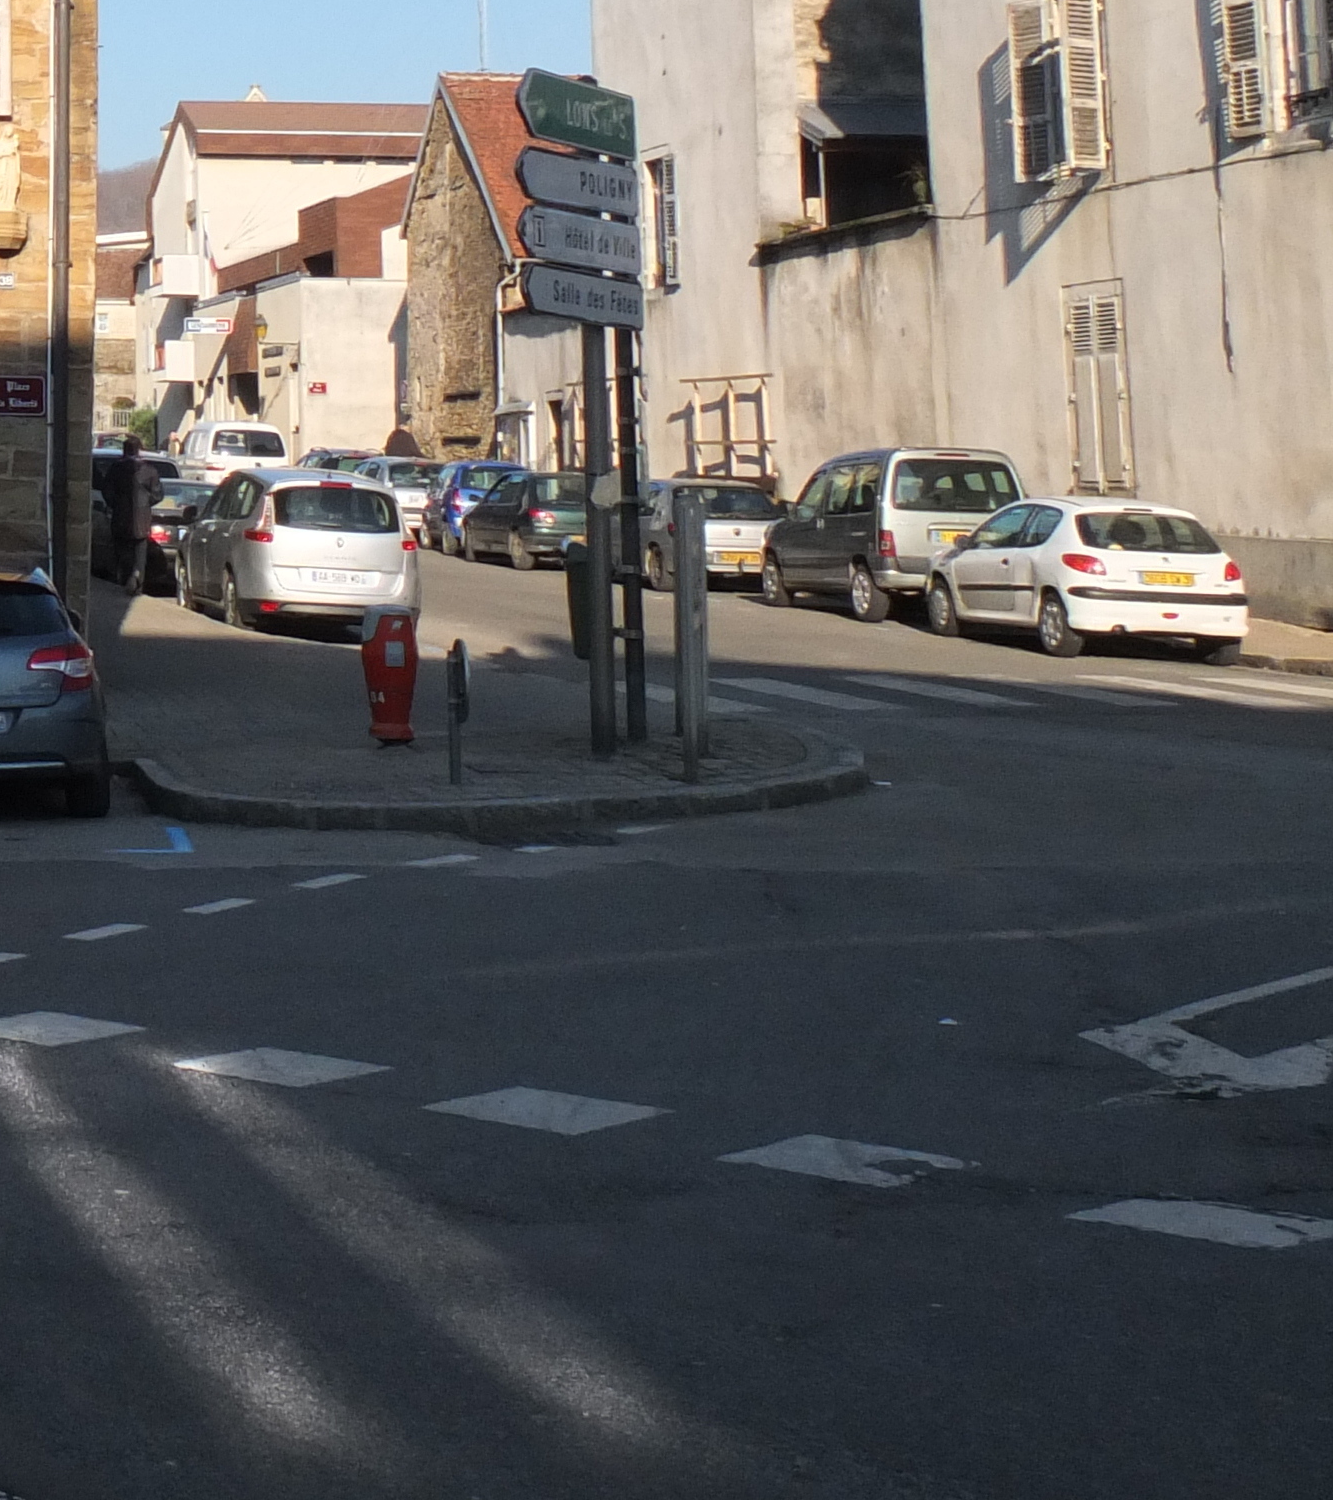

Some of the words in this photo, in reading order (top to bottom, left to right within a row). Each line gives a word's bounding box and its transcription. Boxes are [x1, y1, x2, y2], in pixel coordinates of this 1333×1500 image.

[580, 171, 632, 201] POLIGNY
[598, 233, 609, 254] de
[613, 235, 635, 259] Ville
[553, 279, 580, 305] Salle
[587, 286, 604, 310] des
